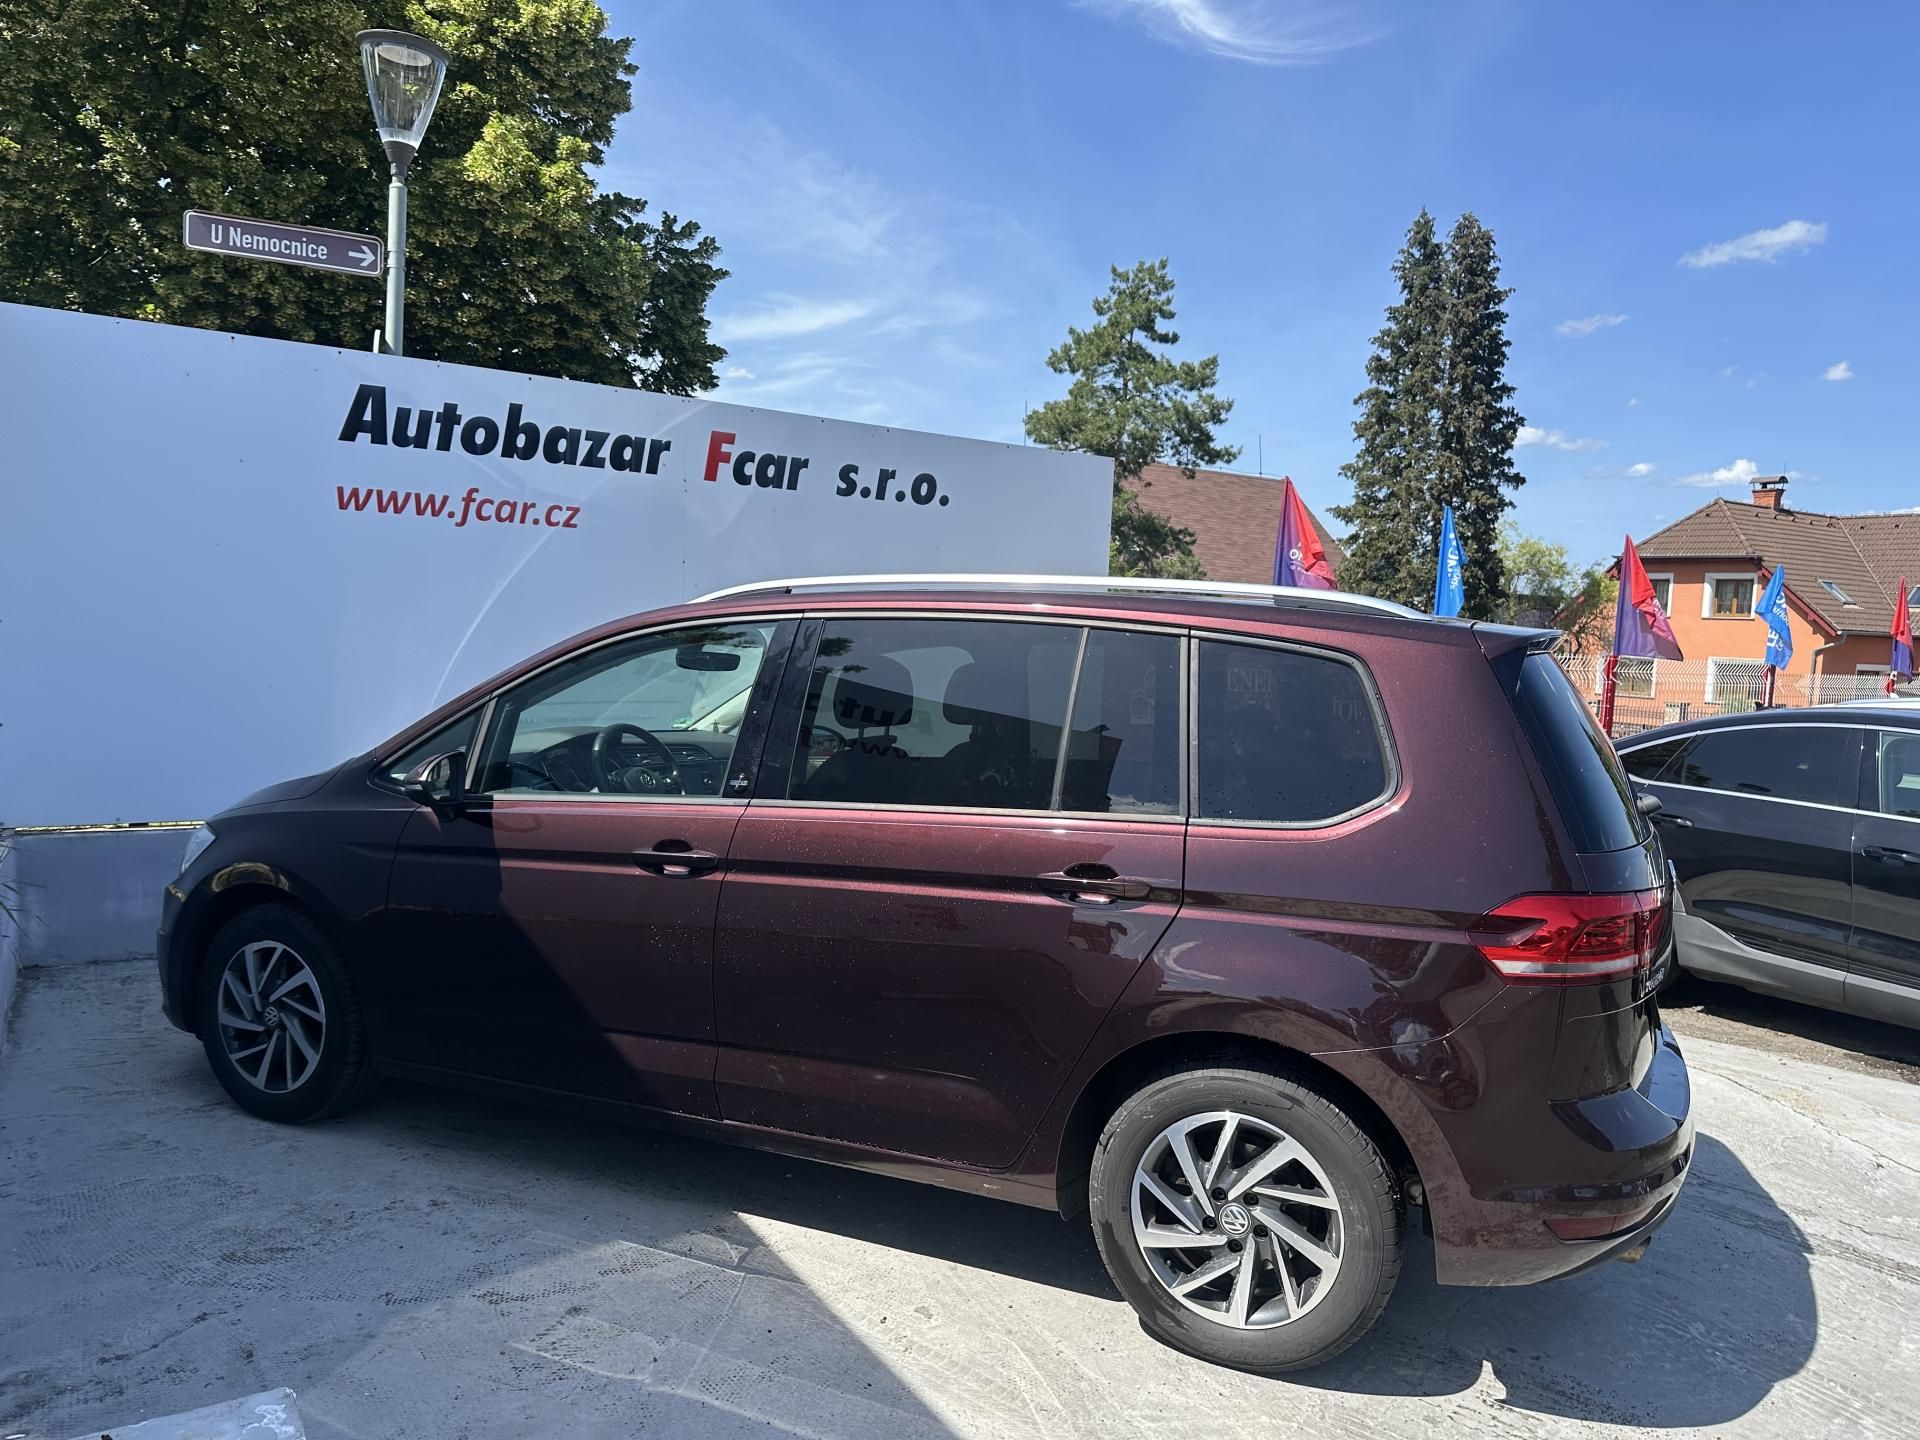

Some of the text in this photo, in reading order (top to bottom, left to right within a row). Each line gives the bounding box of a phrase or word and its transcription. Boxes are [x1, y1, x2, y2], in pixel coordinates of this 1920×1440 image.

[210, 223, 328, 260] U Nemocnice
[337, 383, 951, 507] Autobazar Fcar s.r.o.
[336, 485, 581, 529] www.fcar.cz
